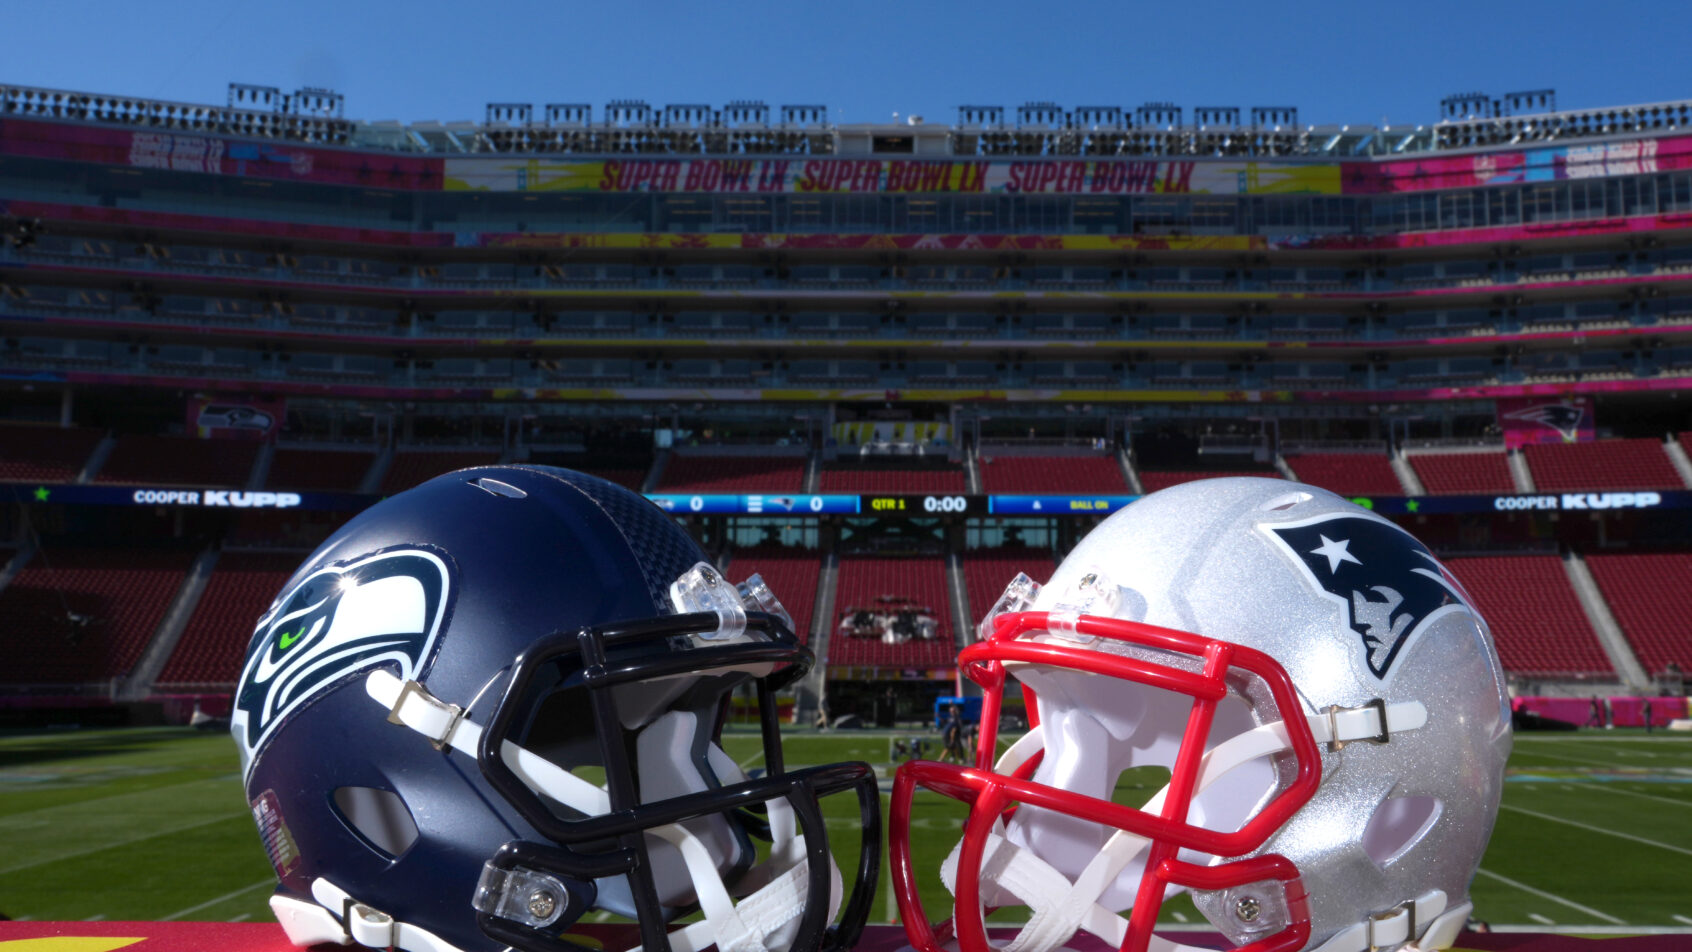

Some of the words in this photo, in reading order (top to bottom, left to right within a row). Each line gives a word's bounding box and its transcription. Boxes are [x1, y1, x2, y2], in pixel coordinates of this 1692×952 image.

[600, 160, 681, 192] SUPER
[684, 160, 752, 192] BOWL
[758, 160, 789, 192] LX
[800, 160, 881, 192] SUPER
[886, 160, 952, 192] BOWL
[960, 160, 991, 192] LX
[1005, 160, 1086, 193] SUPER
[1090, 160, 1158, 193] BOWL
[1163, 160, 1197, 193] LX
[133, 490, 200, 505] COOPER
[203, 490, 301, 507] KUPP
[690, 496, 704, 512] 0
[810, 496, 823, 512] 0
[871, 498, 896, 511] QTR
[898, 498, 906, 511] 1
[923, 495, 967, 513] 0:00
[1069, 500, 1093, 510] BALL
[1094, 500, 1109, 510] ON
[1494, 496, 1557, 510] COOPER
[1561, 491, 1661, 509] KUPP
